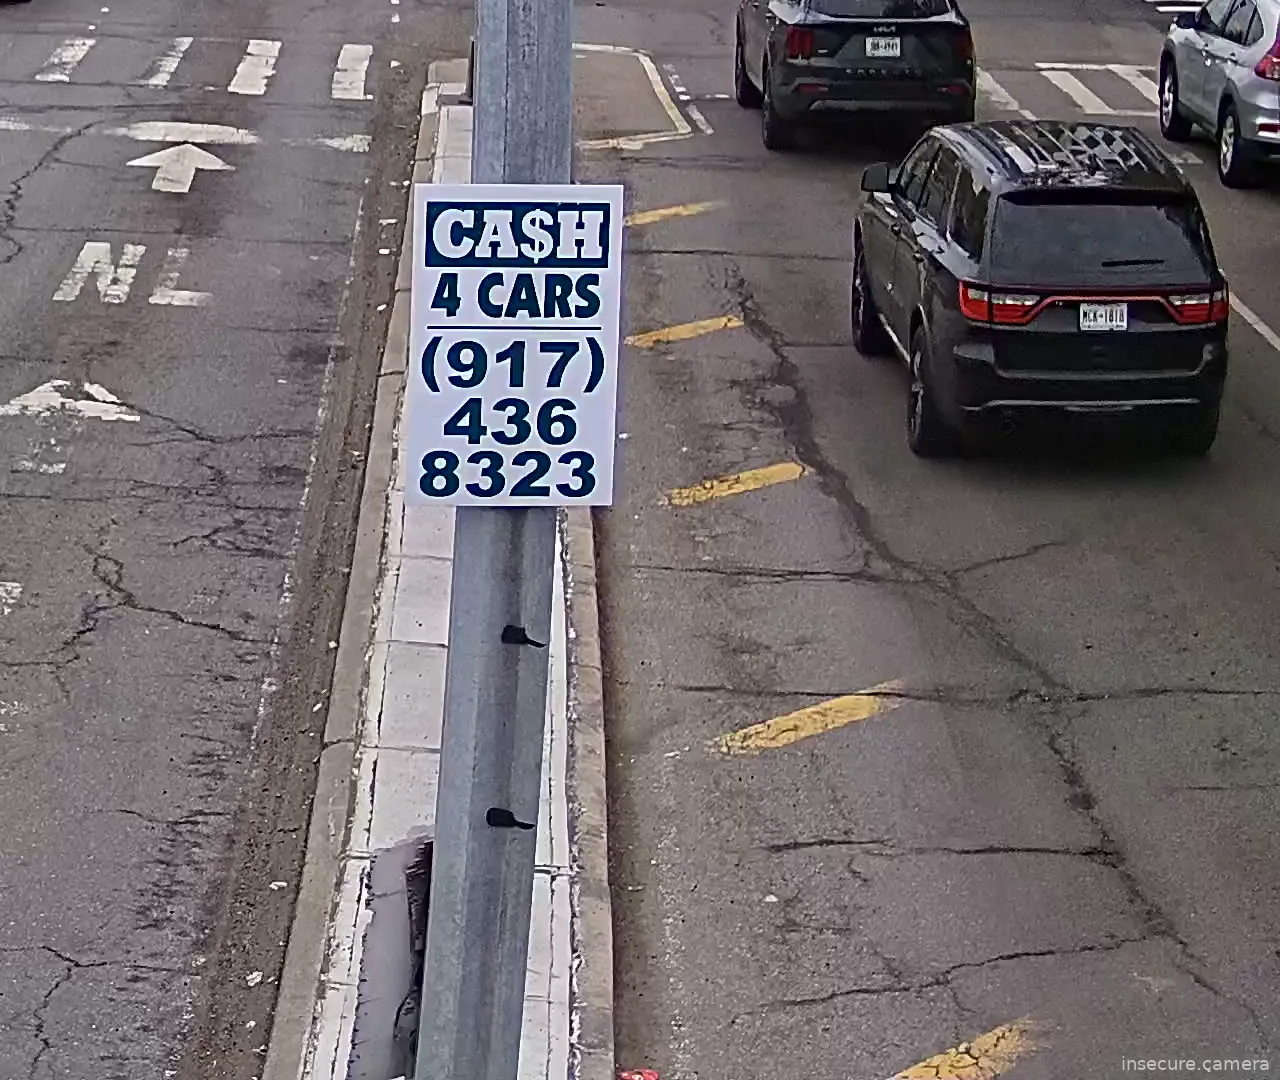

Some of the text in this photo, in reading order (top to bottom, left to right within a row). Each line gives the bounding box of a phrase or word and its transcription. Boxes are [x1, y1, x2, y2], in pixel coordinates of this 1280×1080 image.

[430, 272, 601, 318] 4 CARS
[421, 336, 605, 393] (917)
[443, 398, 577, 446] 436
[419, 450, 596, 498] 8323
